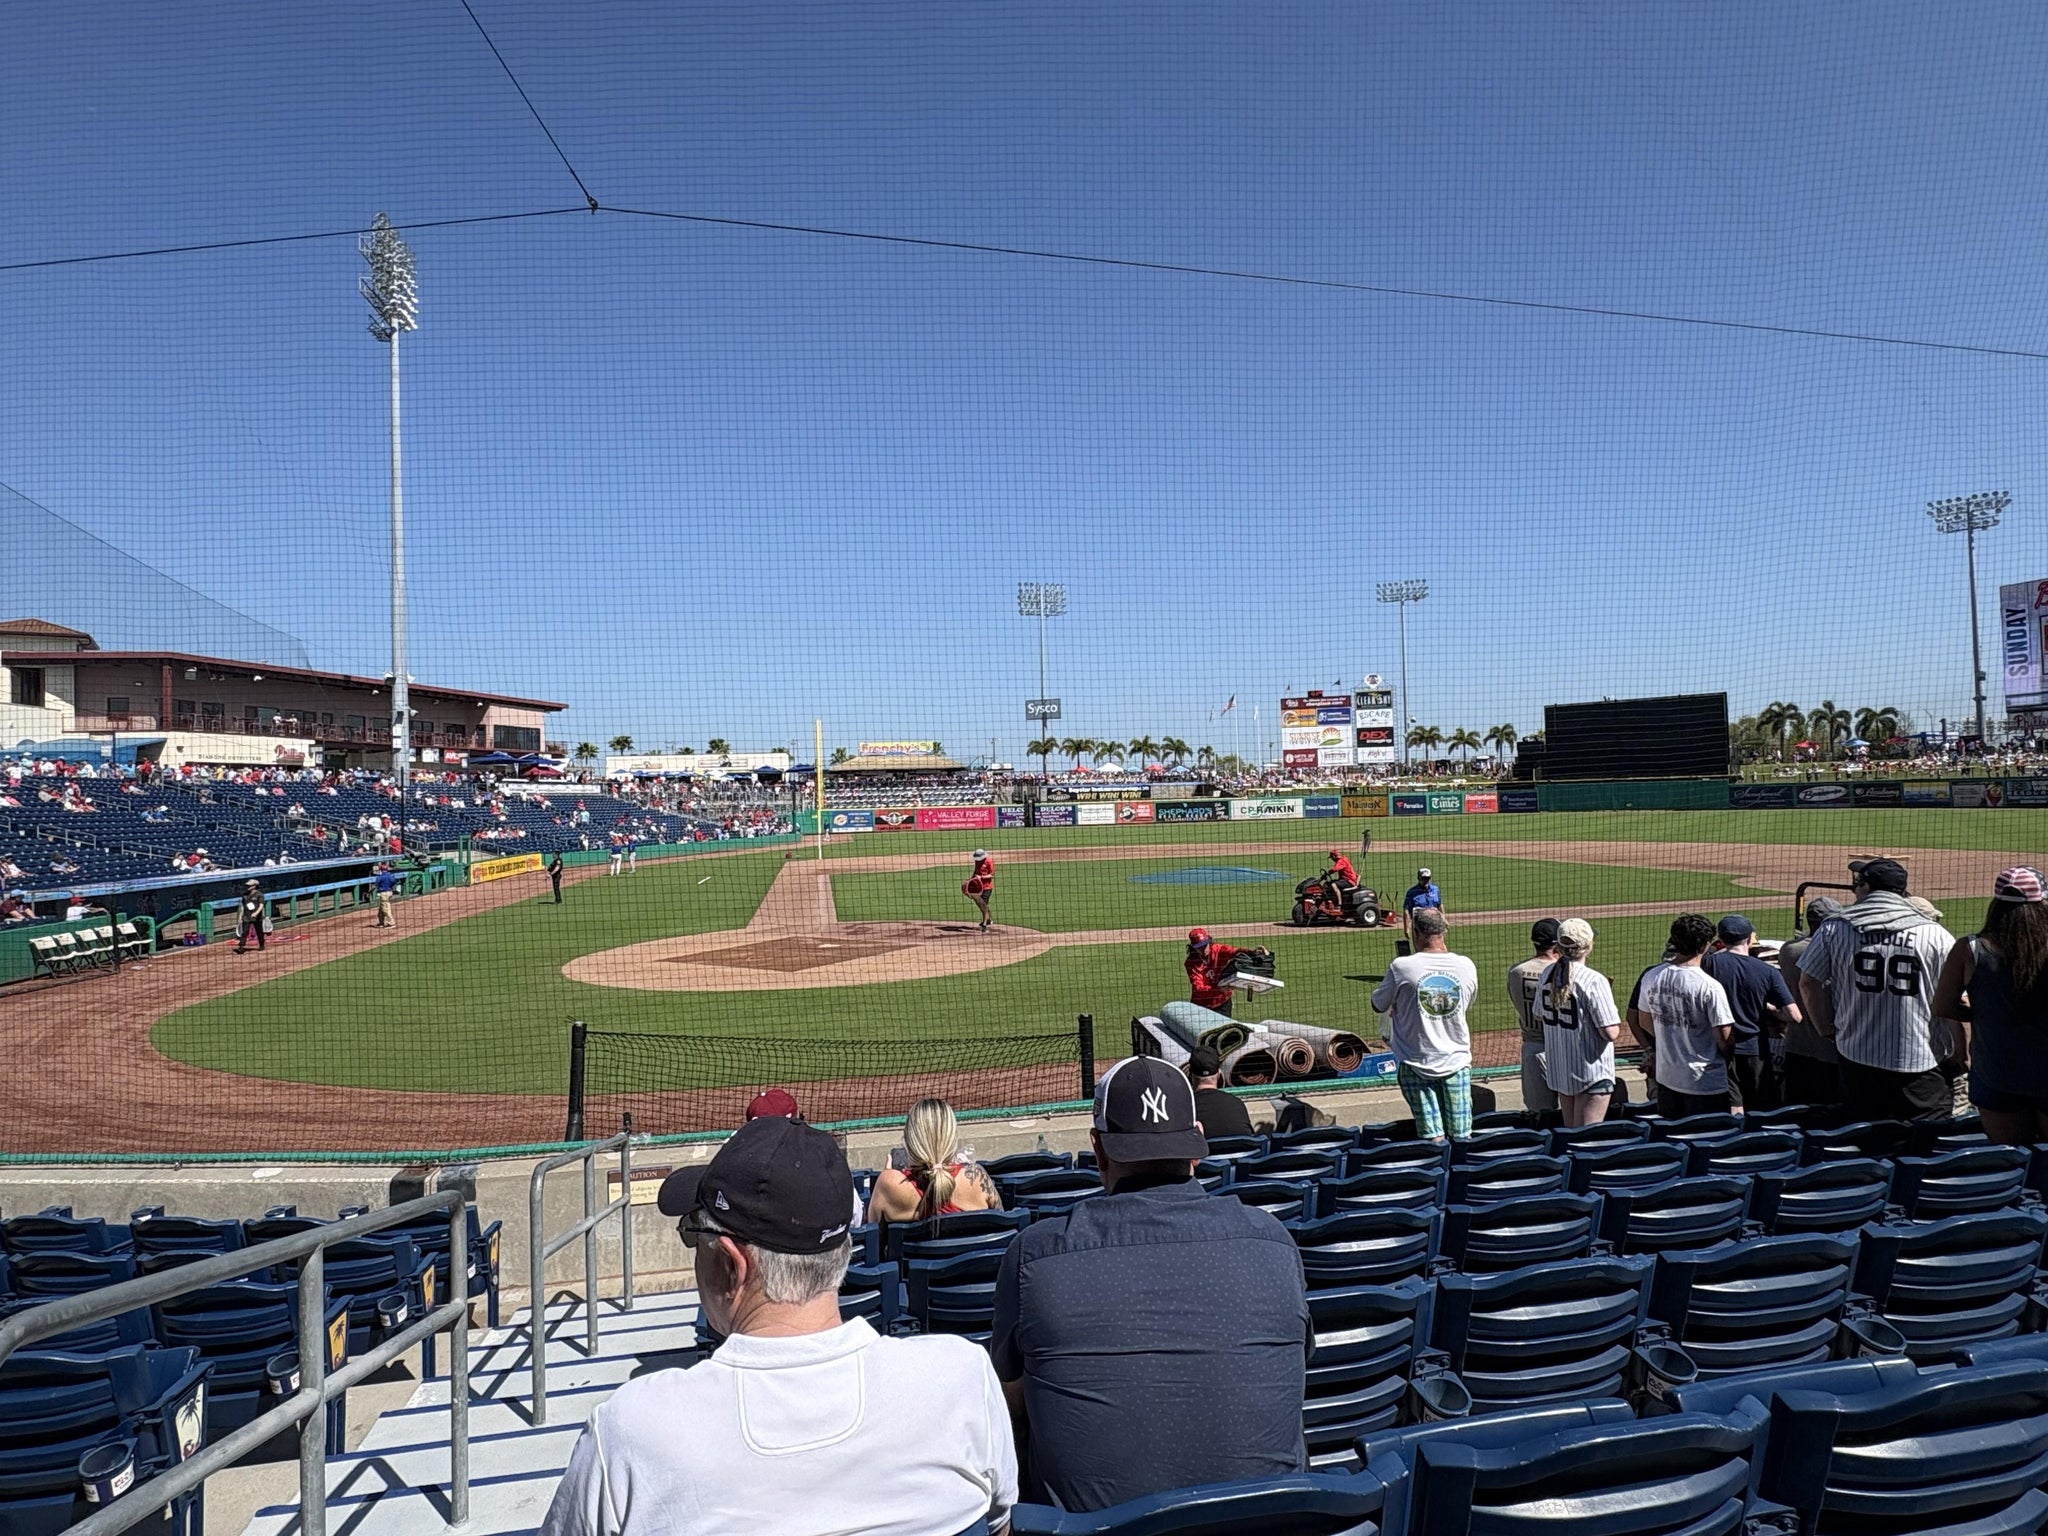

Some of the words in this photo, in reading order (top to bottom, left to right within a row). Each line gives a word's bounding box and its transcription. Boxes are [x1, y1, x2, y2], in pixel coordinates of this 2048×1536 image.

[2005, 608, 2029, 677] SUNDAY
[1027, 702, 1058, 716] Sysco
[1359, 711, 1391, 720] ESCAPE
[1360, 731, 1389, 740] DEX
[861, 743, 920, 753] Frenchy's
[1121, 791, 1142, 799] WIN!
[1432, 797, 1460, 809] Times
[1158, 807, 1212, 816] SHEPHARD'S
[1860, 930, 1917, 949] JUDGE
[1854, 951, 1921, 997] 99
[1140, 1086, 1169, 1123] NY
[629, 1170, 658, 1180] AUTION
